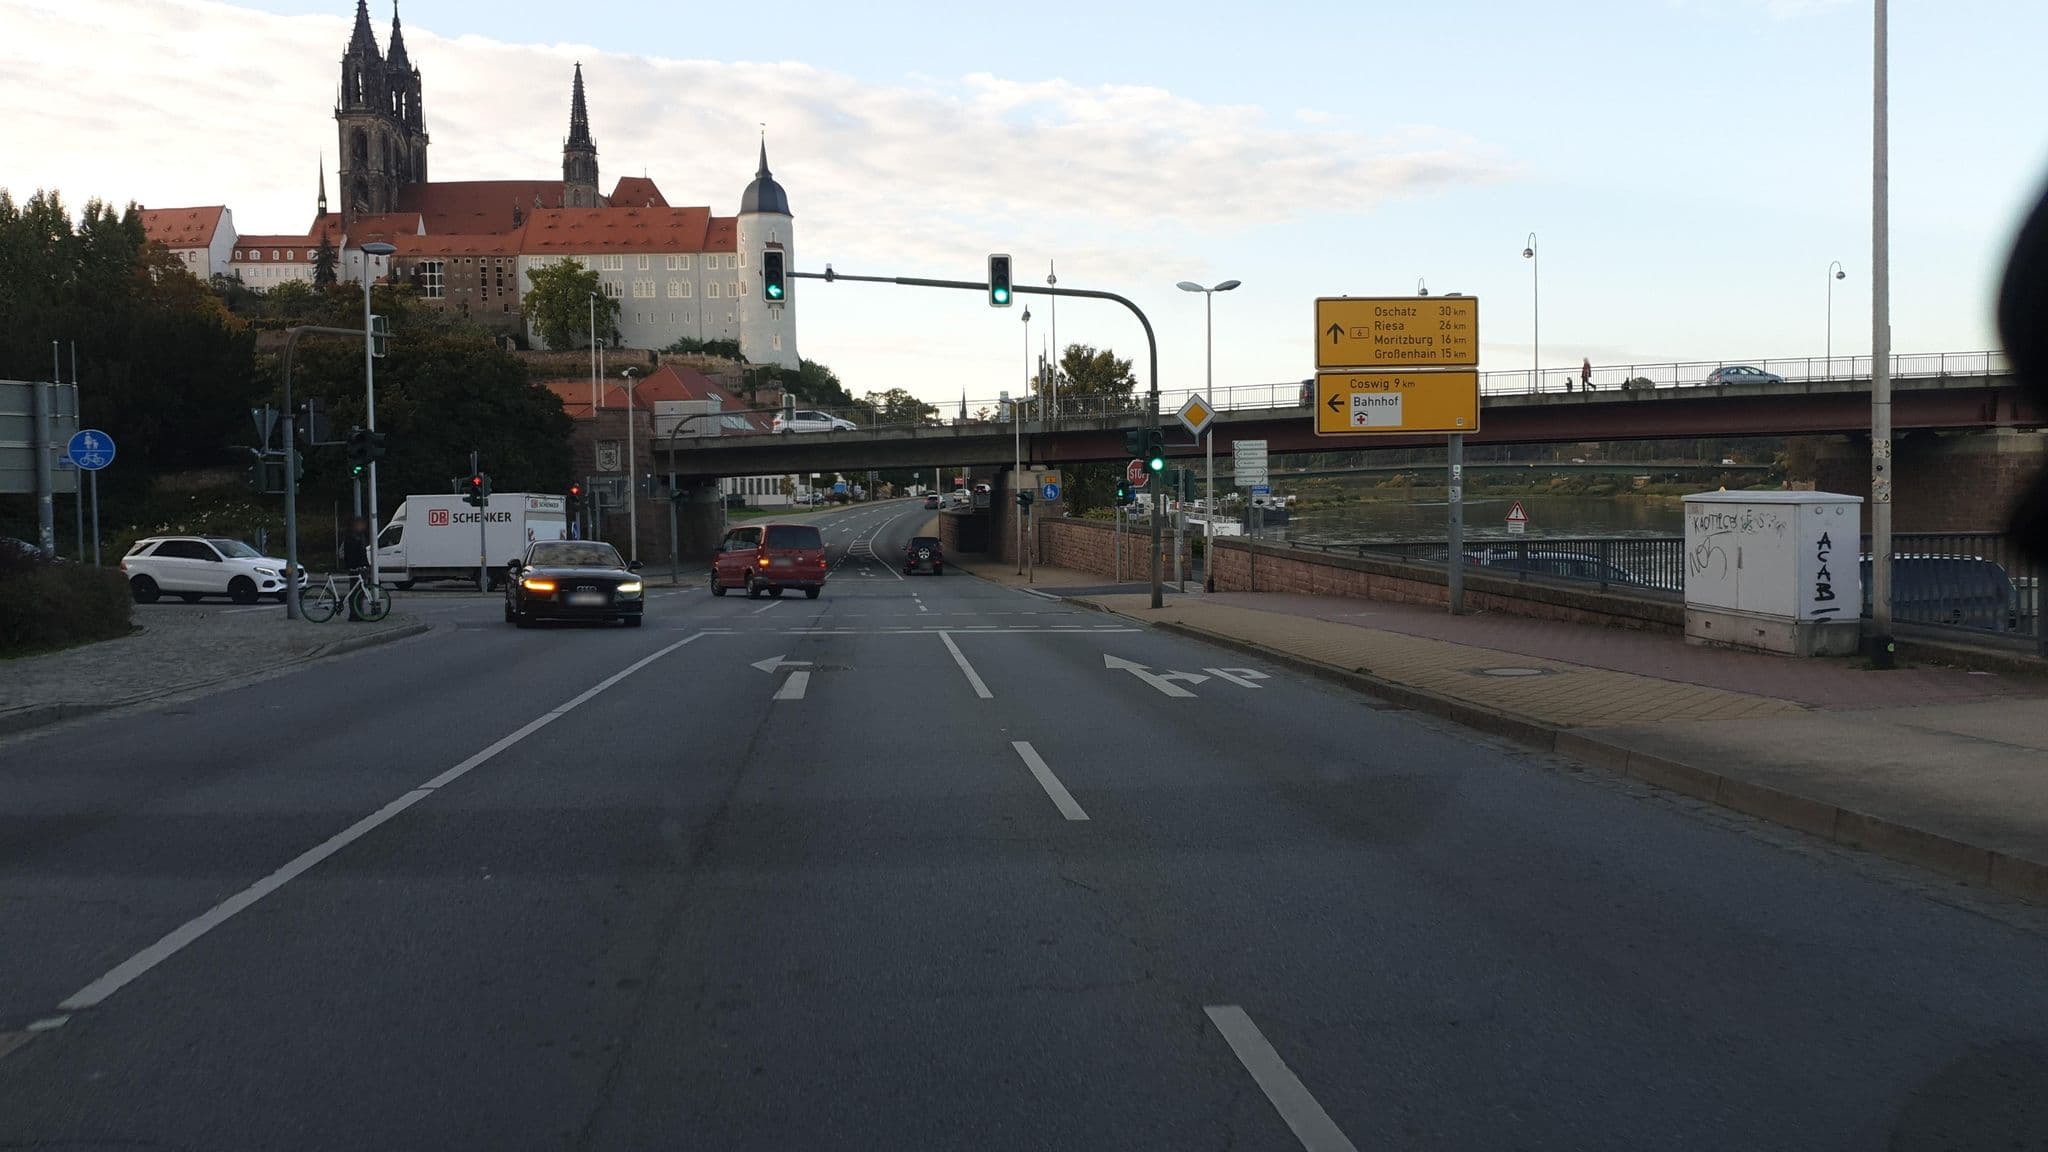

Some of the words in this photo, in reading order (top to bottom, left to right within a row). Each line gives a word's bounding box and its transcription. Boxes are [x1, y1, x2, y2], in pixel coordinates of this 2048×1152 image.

[1375, 306, 1417, 317] Oschatz
[1439, 306, 1451, 316] 30
[1453, 307, 1466, 316] km
[1374, 321, 1405, 331] Riesa
[1439, 321, 1451, 330] 26
[1453, 321, 1466, 330] km
[1374, 335, 1433, 346] Moritzburg
[1441, 334, 1451, 344] 16
[1453, 335, 1467, 344] km
[1374, 349, 1437, 360] Großenhain
[1441, 348, 1451, 359] 15
[1453, 350, 1467, 358] km
[1350, 379, 1390, 391] Coswig
[1394, 378, 1400, 388] 9
[1402, 379, 1416, 388] km
[1353, 396, 1399, 407] Bahnhof
[430, 511, 448, 524] DB
[452, 511, 512, 524] SCHENKER
